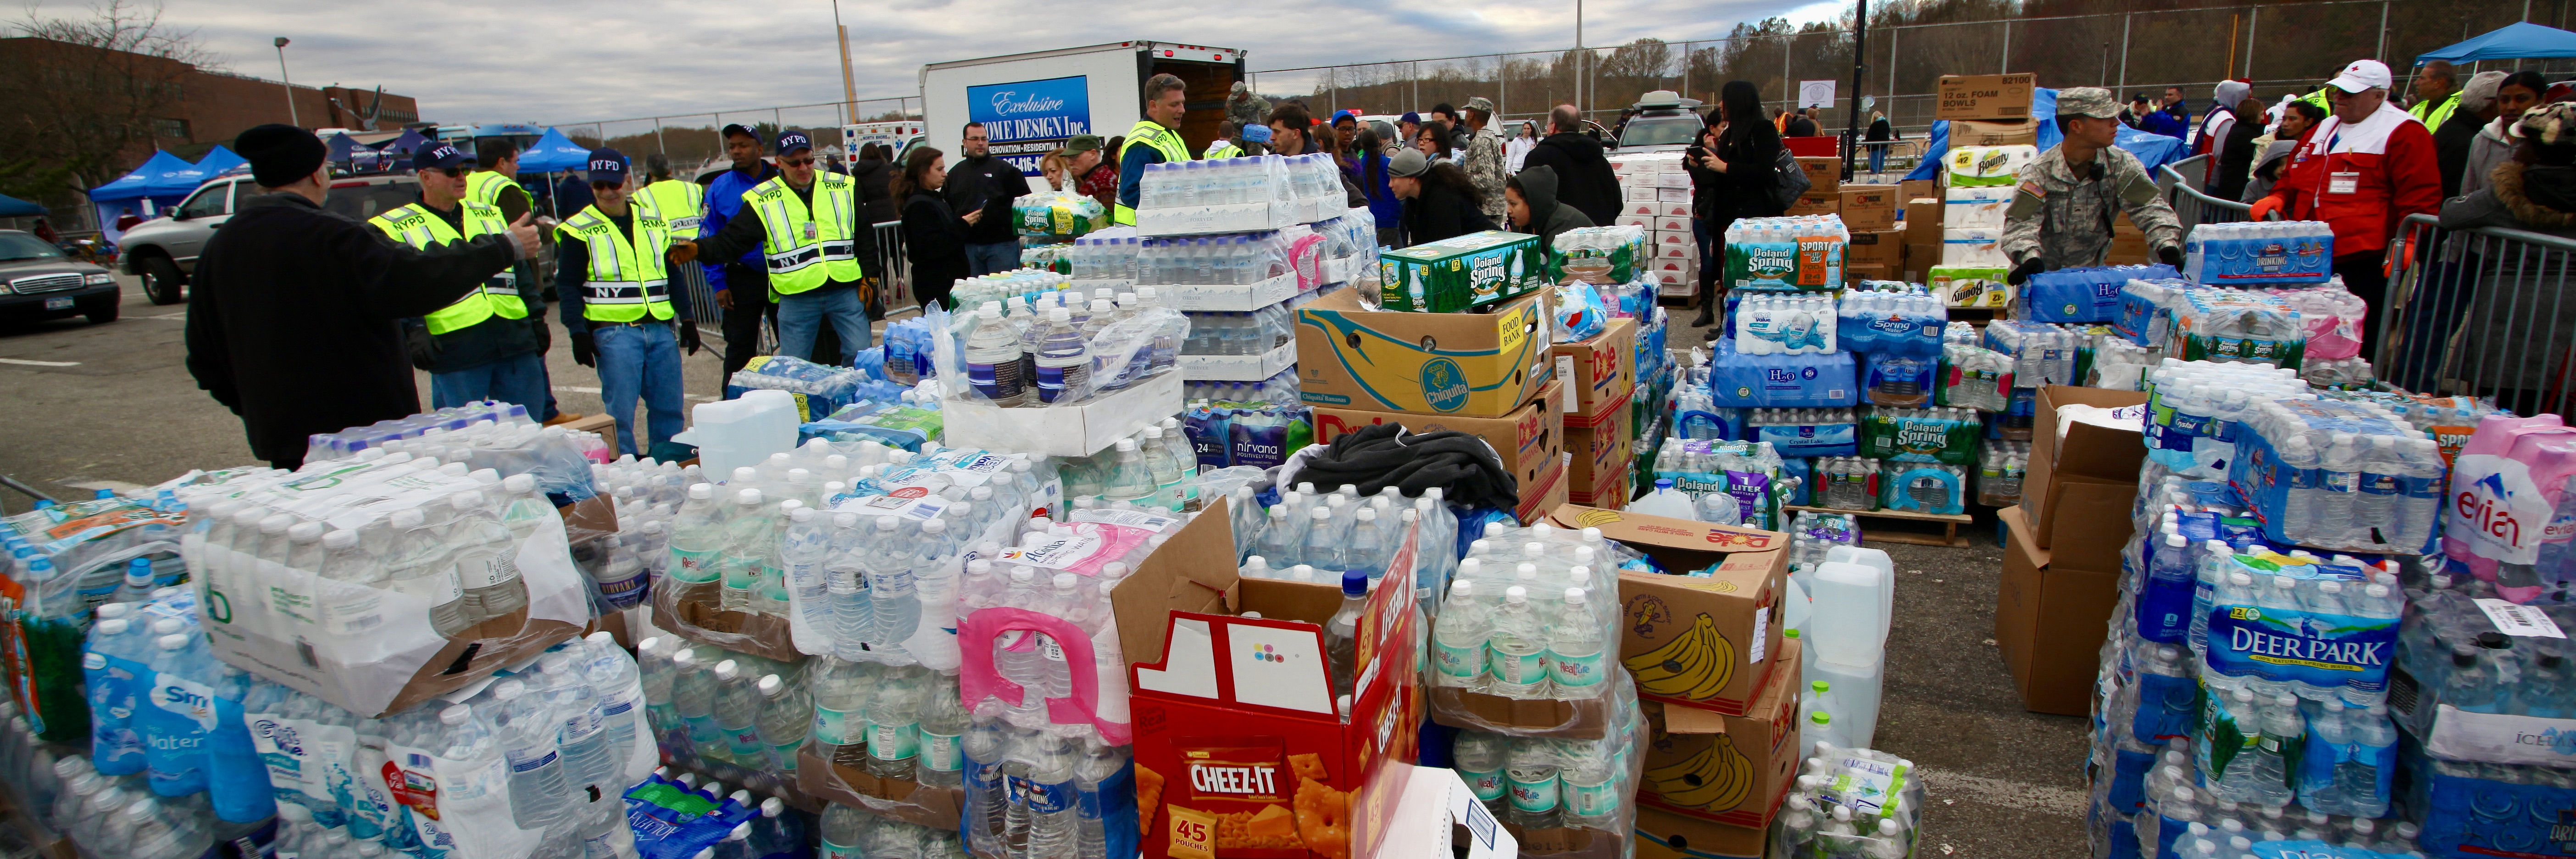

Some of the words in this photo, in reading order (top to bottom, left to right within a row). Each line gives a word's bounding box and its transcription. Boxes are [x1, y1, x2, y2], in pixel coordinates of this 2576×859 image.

[2003, 76, 2030, 84] 82100
[992, 91, 1064, 116] Exclusive
[980, 120, 1013, 141] OME
[1014, 116, 1062, 139] DESIGN
[1064, 115, 1088, 135] Inc.
[781, 135, 806, 148] NYPD
[989, 144, 1021, 155] RENOVATION
[1023, 142, 1057, 152] RESIDENTIAL
[591, 159, 619, 171] NYPD
[1978, 153, 2009, 177] Bounty
[758, 190, 783, 203] NYPD
[393, 215, 426, 232] NYPD
[1025, 216, 1049, 227] Spring
[1753, 248, 1790, 258] Poland
[1801, 241, 1829, 251] SPORT
[779, 254, 799, 268] NY
[1474, 253, 1502, 269] Poland
[1748, 257, 1794, 273] Spring
[2256, 257, 2287, 266] DRINKING
[1470, 265, 1505, 289] Spring
[596, 287, 622, 298] NY
[1952, 279, 1984, 303] Bounty
[1502, 317, 1519, 335] FOOD
[1874, 320, 1910, 330] Spring
[1504, 328, 1521, 346] BANK
[2218, 343, 2238, 352] Spring
[1593, 342, 1616, 383] Dole
[1427, 383, 1468, 404] Chiquita
[1518, 414, 1538, 448] Dole
[1904, 421, 1944, 434] Poland
[1596, 418, 1615, 459] Dole
[1897, 430, 1947, 449] Spring
[1197, 443, 1209, 453] 24
[1237, 441, 1277, 455] nirvana
[1519, 445, 1539, 468] BANANAS
[1677, 477, 1719, 494] Poland
[1732, 484, 1761, 492] LITER
[1740, 476, 1749, 485] 1
[2457, 491, 2519, 547] evian
[1705, 532, 1771, 548] Dole
[1025, 539, 1069, 563] Acadia
[1039, 552, 1060, 564] NATURAL
[1047, 549, 1074, 565] SPRING
[600, 579, 636, 594] NIRVANA
[1380, 575, 1406, 647] CHEEZ-IT
[1624, 598, 1633, 617] HANGIN'
[1651, 594, 1663, 606] COOL
[2232, 608, 2243, 616] 12
[1361, 632, 1371, 658] 45
[2231, 625, 2306, 658] DEER
[2307, 640, 2387, 665] PARK
[1560, 661, 1590, 676] RealPure
[1140, 709, 1166, 729] Real
[1378, 685, 1402, 754] CHEEZ-IT
[1772, 702, 1789, 747] Dole
[979, 770, 1002, 782] DRINKING
[1191, 764, 1276, 794] CHEEZ-IT
[1477, 776, 1503, 789] RealPure
[1512, 785, 1539, 801] RealPure
[1176, 819, 1207, 842] 45
[1175, 838, 1209, 853] POUCHES
